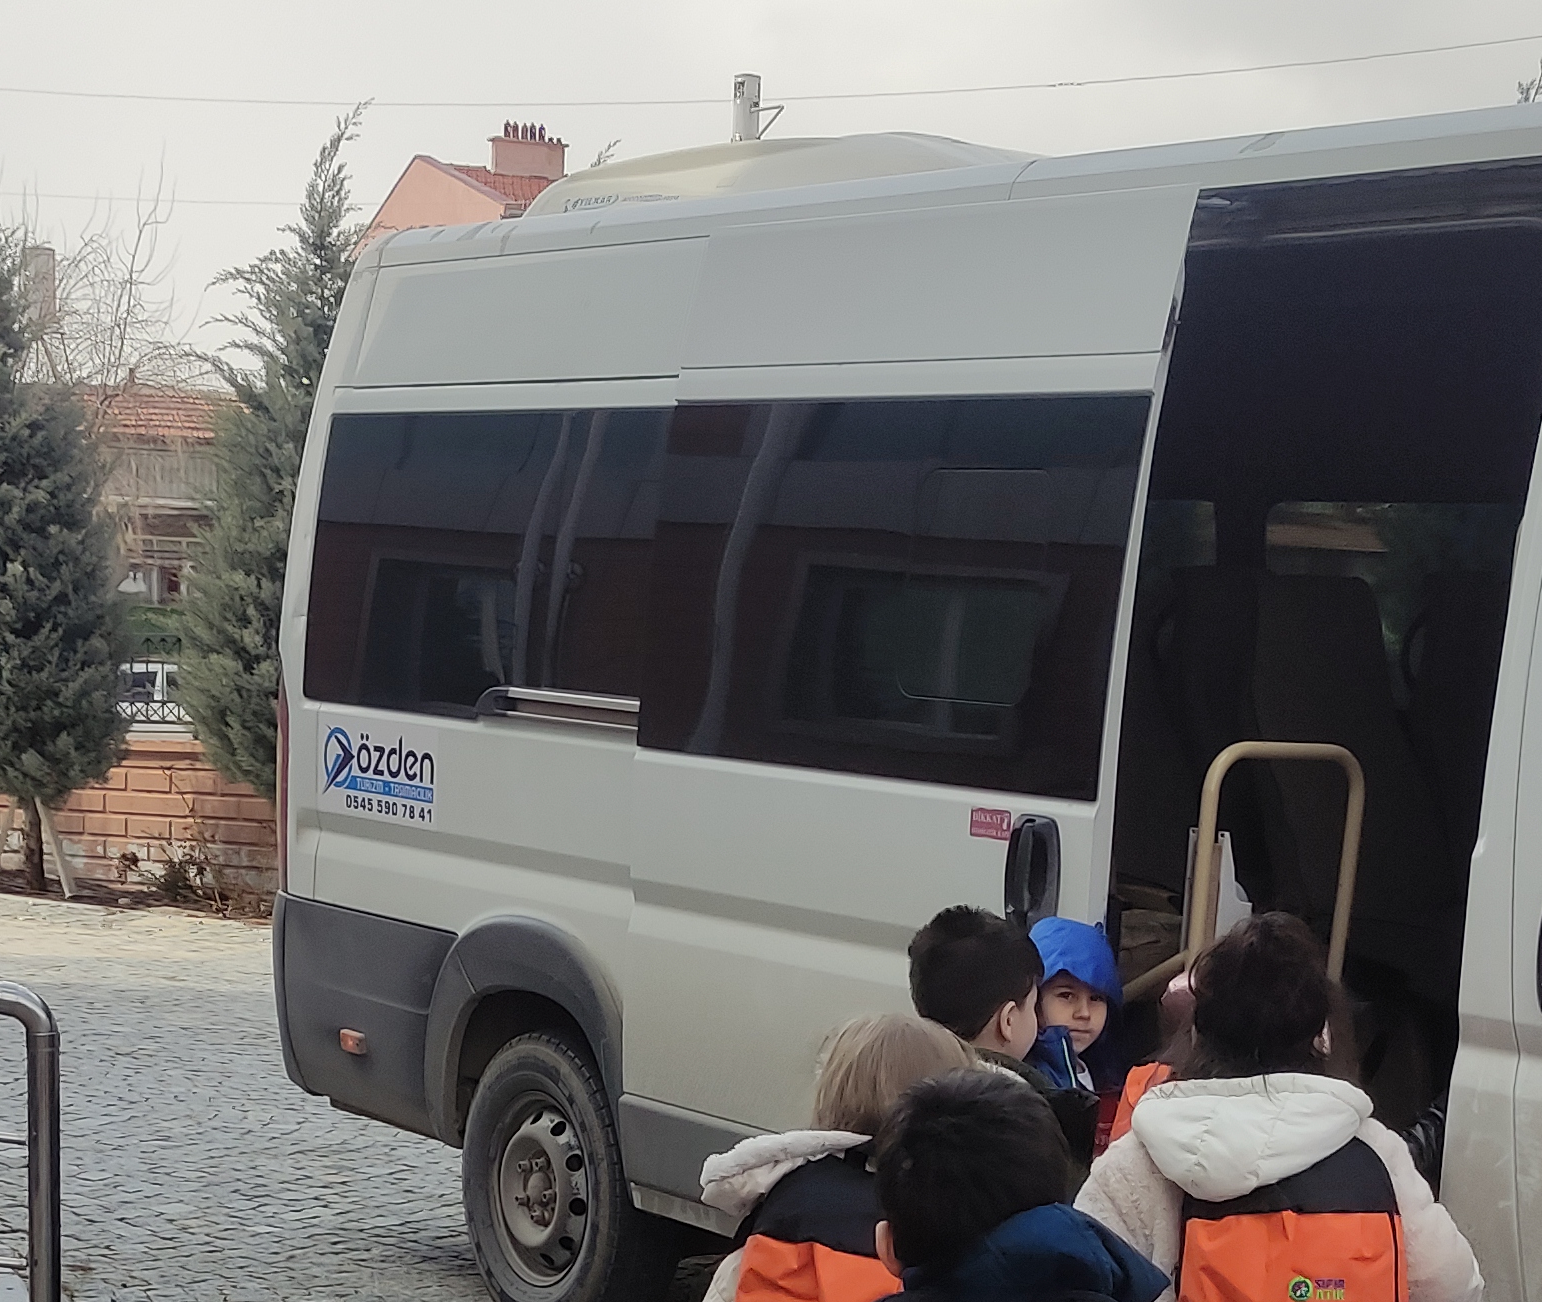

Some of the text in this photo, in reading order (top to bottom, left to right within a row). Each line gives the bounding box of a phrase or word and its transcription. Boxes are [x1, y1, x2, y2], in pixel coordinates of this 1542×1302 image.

[357, 733, 434, 785] özden
[346, 794, 432, 823] 0545 590 78 41
